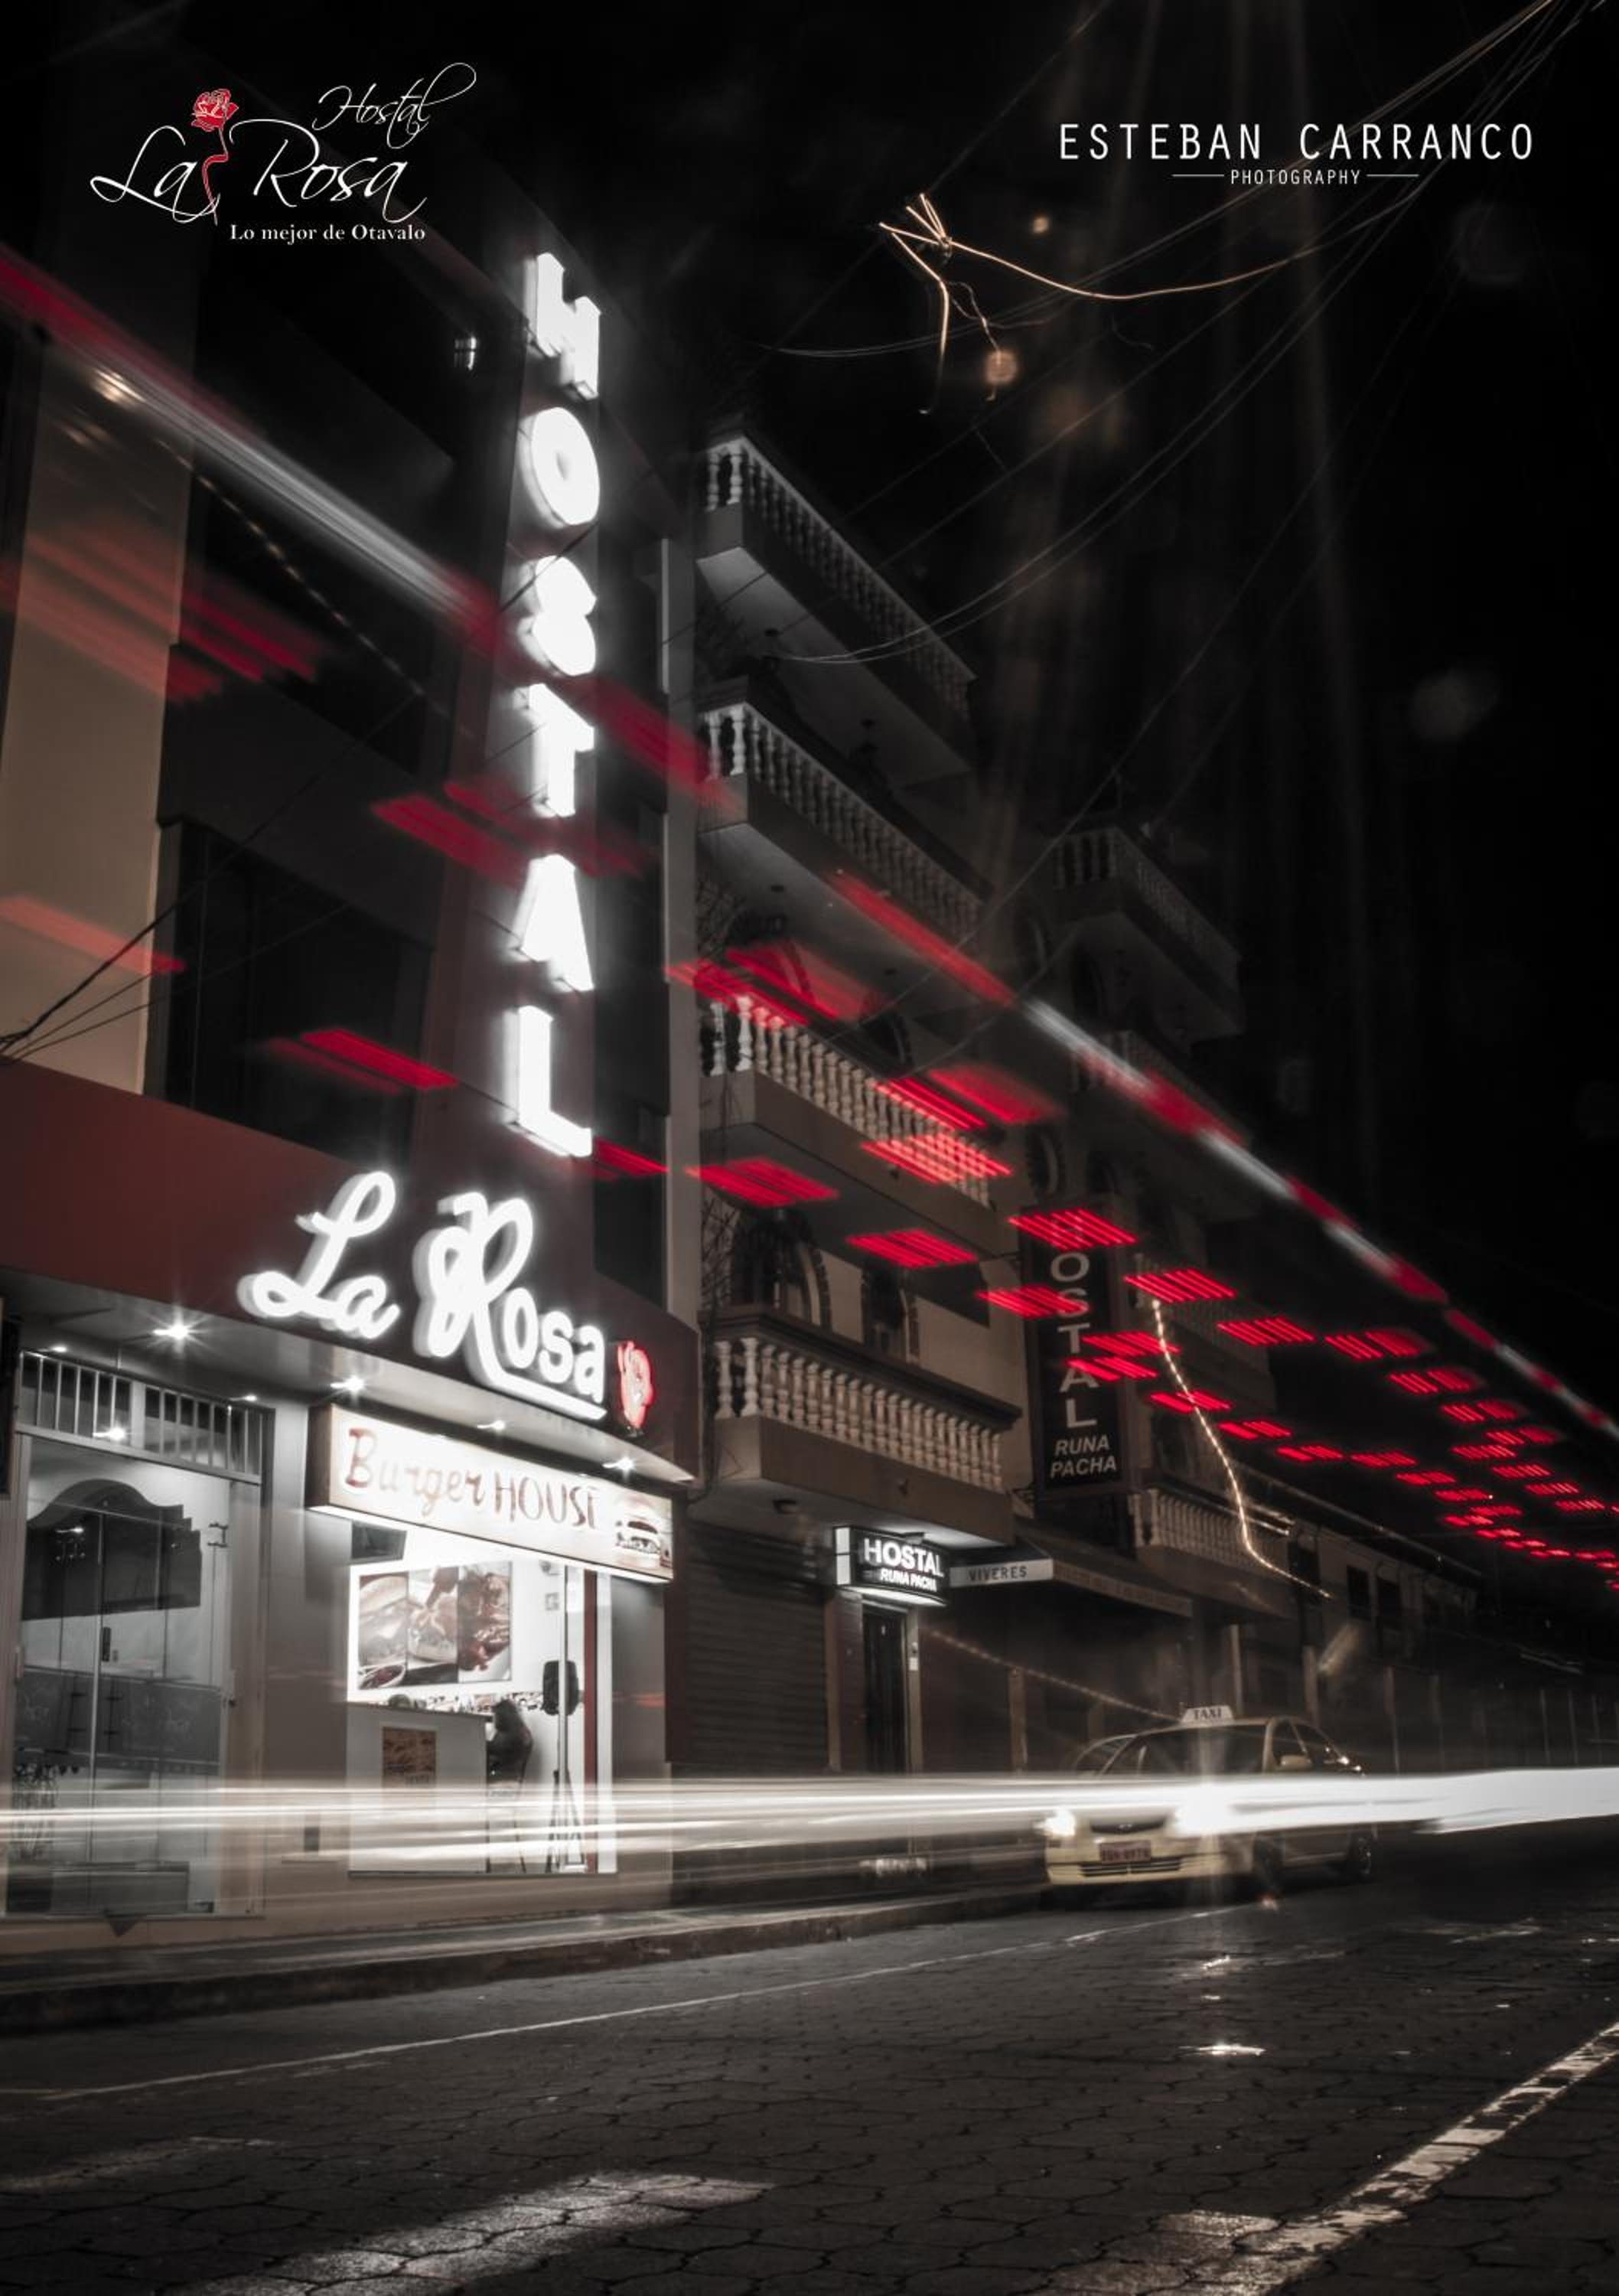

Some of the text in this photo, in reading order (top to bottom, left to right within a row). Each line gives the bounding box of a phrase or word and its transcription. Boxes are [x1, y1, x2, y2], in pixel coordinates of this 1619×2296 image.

[507, 252, 601, 1157] HOSTAL
[238, 1171, 607, 1420] La Rosa
[1054, 1434, 1111, 1456] RUNA
[345, 1427, 485, 1518] Burger
[1050, 1456, 1118, 1479] PACHA
[863, 1538, 945, 1577] HOSTAL
[968, 1564, 1028, 1582] VIVERES
[1193, 1707, 1222, 1720] TAXI
